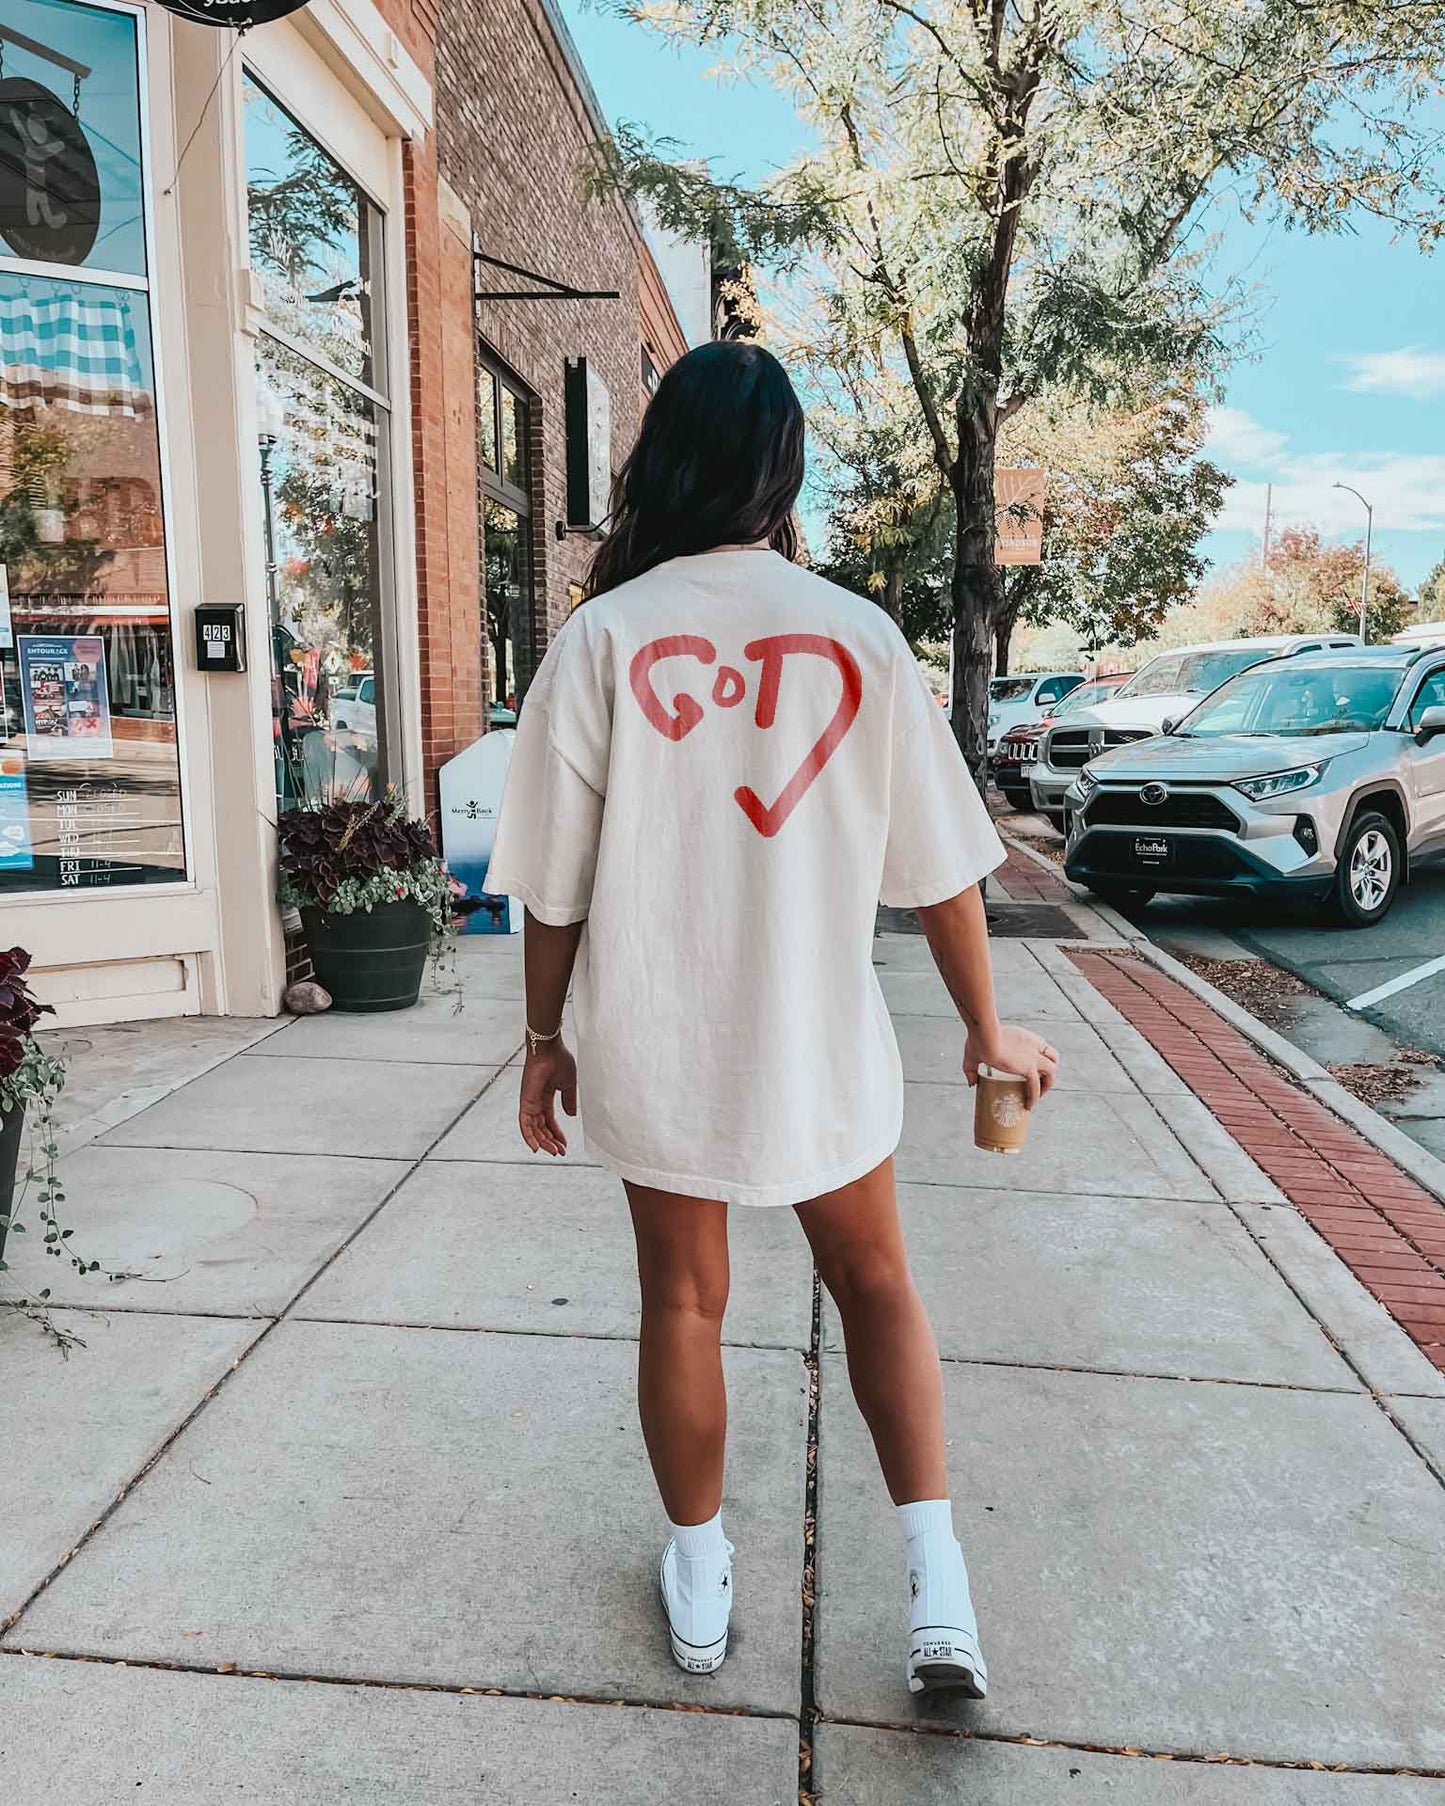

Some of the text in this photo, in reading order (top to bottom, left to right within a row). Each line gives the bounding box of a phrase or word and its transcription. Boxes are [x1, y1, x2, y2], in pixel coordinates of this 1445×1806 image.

[204, 626, 229, 640] 423
[57, 790, 77, 801] SUN
[57, 804, 77, 814] MON
[60, 833, 80, 843] WED
[1135, 842, 1168, 852] EchoPark
[60, 861, 80, 872] FRI
[61, 873, 112, 886] SAT 11-4
